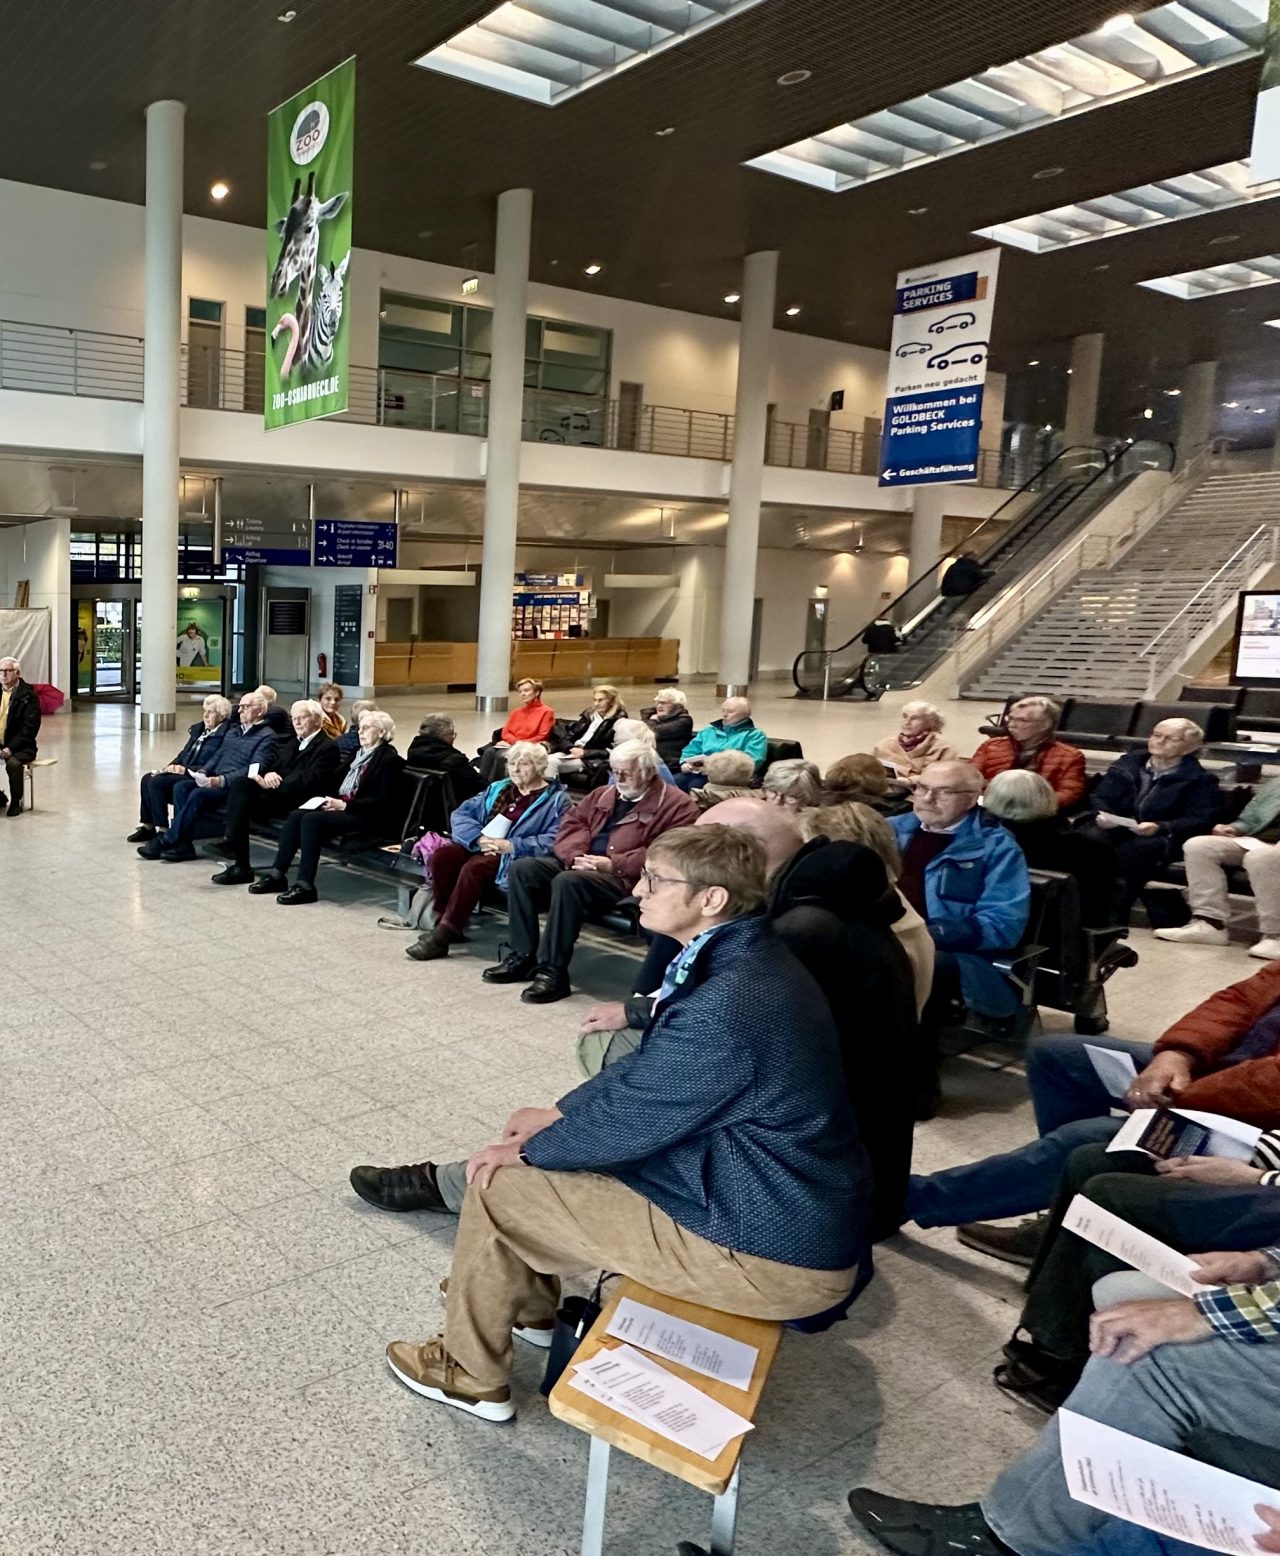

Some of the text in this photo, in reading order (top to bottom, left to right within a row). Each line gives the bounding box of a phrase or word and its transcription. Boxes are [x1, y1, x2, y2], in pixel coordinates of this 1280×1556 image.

[296, 129, 320, 151] ZOO
[903, 281, 952, 299] PARKING
[902, 291, 953, 310] SERVICES
[272, 375, 339, 410] ZOO-OSNABRUECK.DE
[895, 384, 922, 392] Parken
[943, 375, 978, 387] gedacht
[893, 394, 976, 414] Willkommen bei
[892, 410, 945, 425] GOLDBECK
[890, 419, 975, 436] Parking Services
[899, 464, 975, 477] Geschäftsführung
